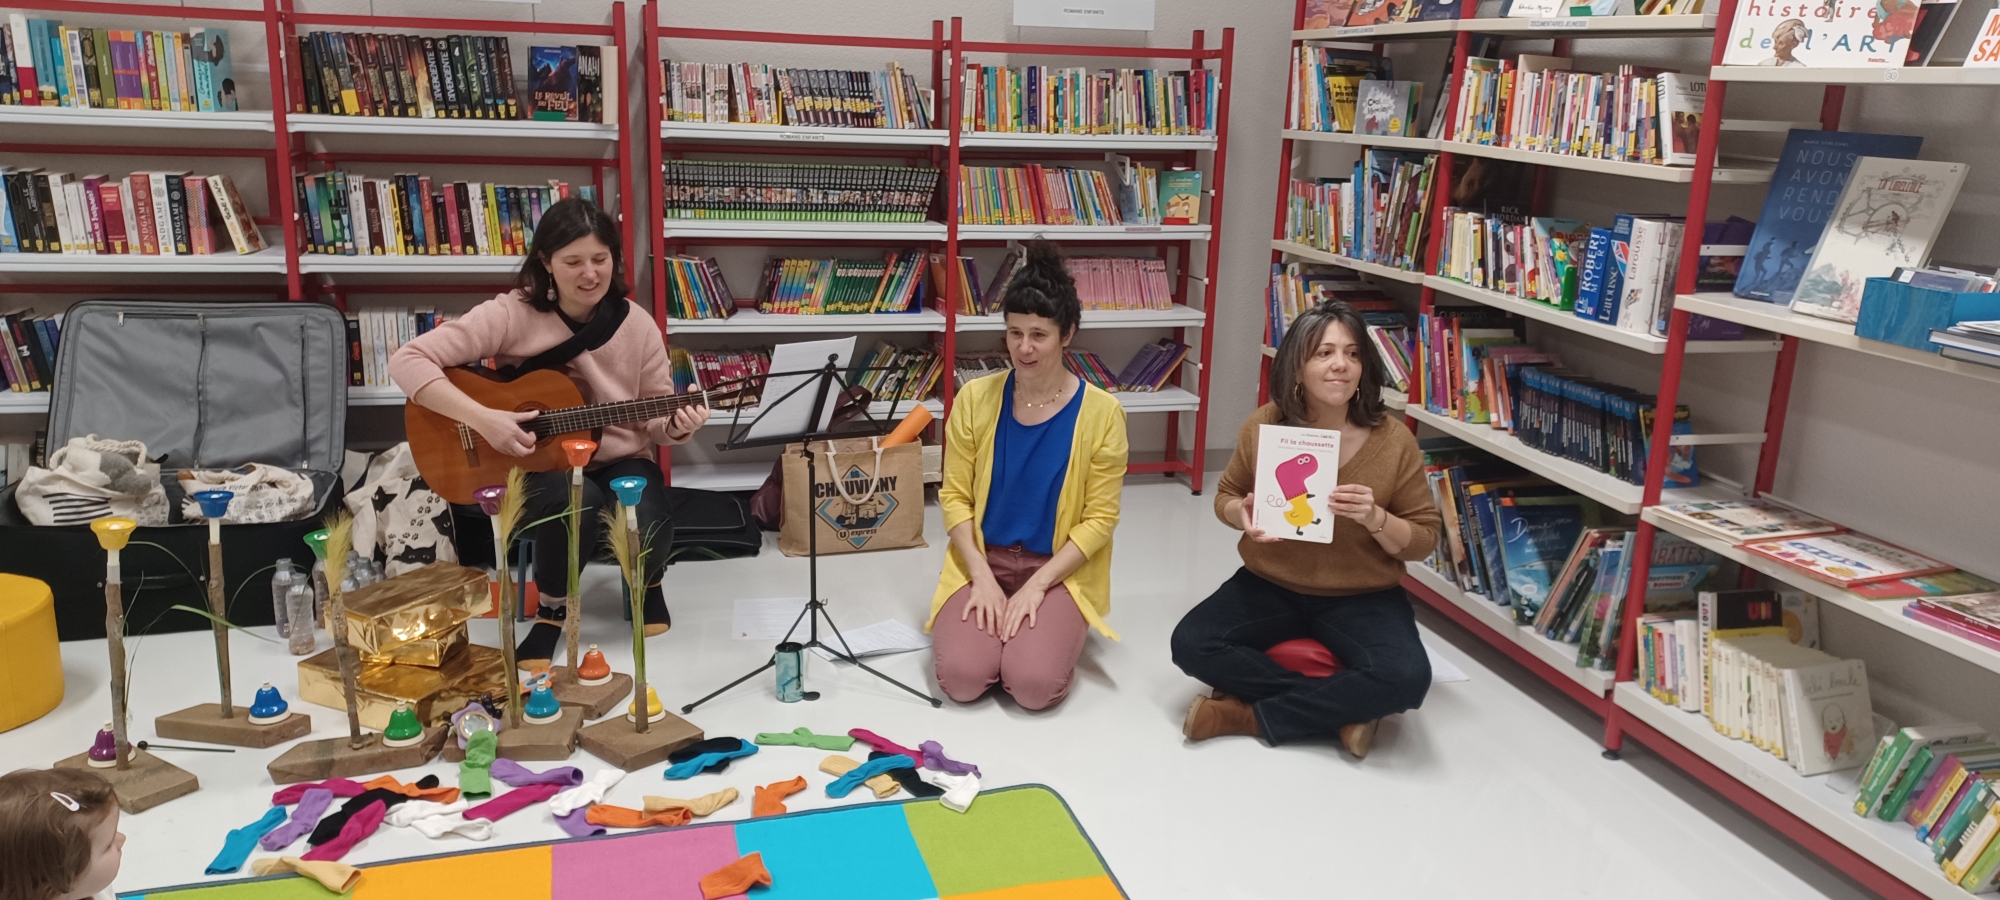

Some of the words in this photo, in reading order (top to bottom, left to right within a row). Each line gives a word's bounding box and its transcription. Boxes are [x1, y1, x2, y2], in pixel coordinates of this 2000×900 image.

[1748, 0, 1879, 18] histoire
[439, 41, 445, 49] 3
[1739, 28, 1772, 50] de
[426, 51, 443, 101] DIVERGENTE
[440, 51, 456, 101] DIVERGENTE
[1657, 76, 1666, 97] LOTI
[547, 100, 568, 111] FEU
[1796, 149, 1857, 168] NOUS
[25, 173, 38, 212] LABYRINTHE
[137, 201, 150, 246] ENDGAME
[156, 201, 168, 246] ENDGAME
[171, 202, 183, 245] ENDGAME
[1501, 206, 1519, 214] RICK
[1591, 236, 1607, 293] MICRO
[1628, 226, 1643, 280] Larousse
[1577, 297, 1586, 313] LE
[1582, 232, 1600, 292] ROBERT
[1599, 266, 1618, 321] Larousse
[1298, 440, 1334, 448] chaussette
[851, 528, 877, 537] express
[1652, 546, 1705, 564] IRATES
